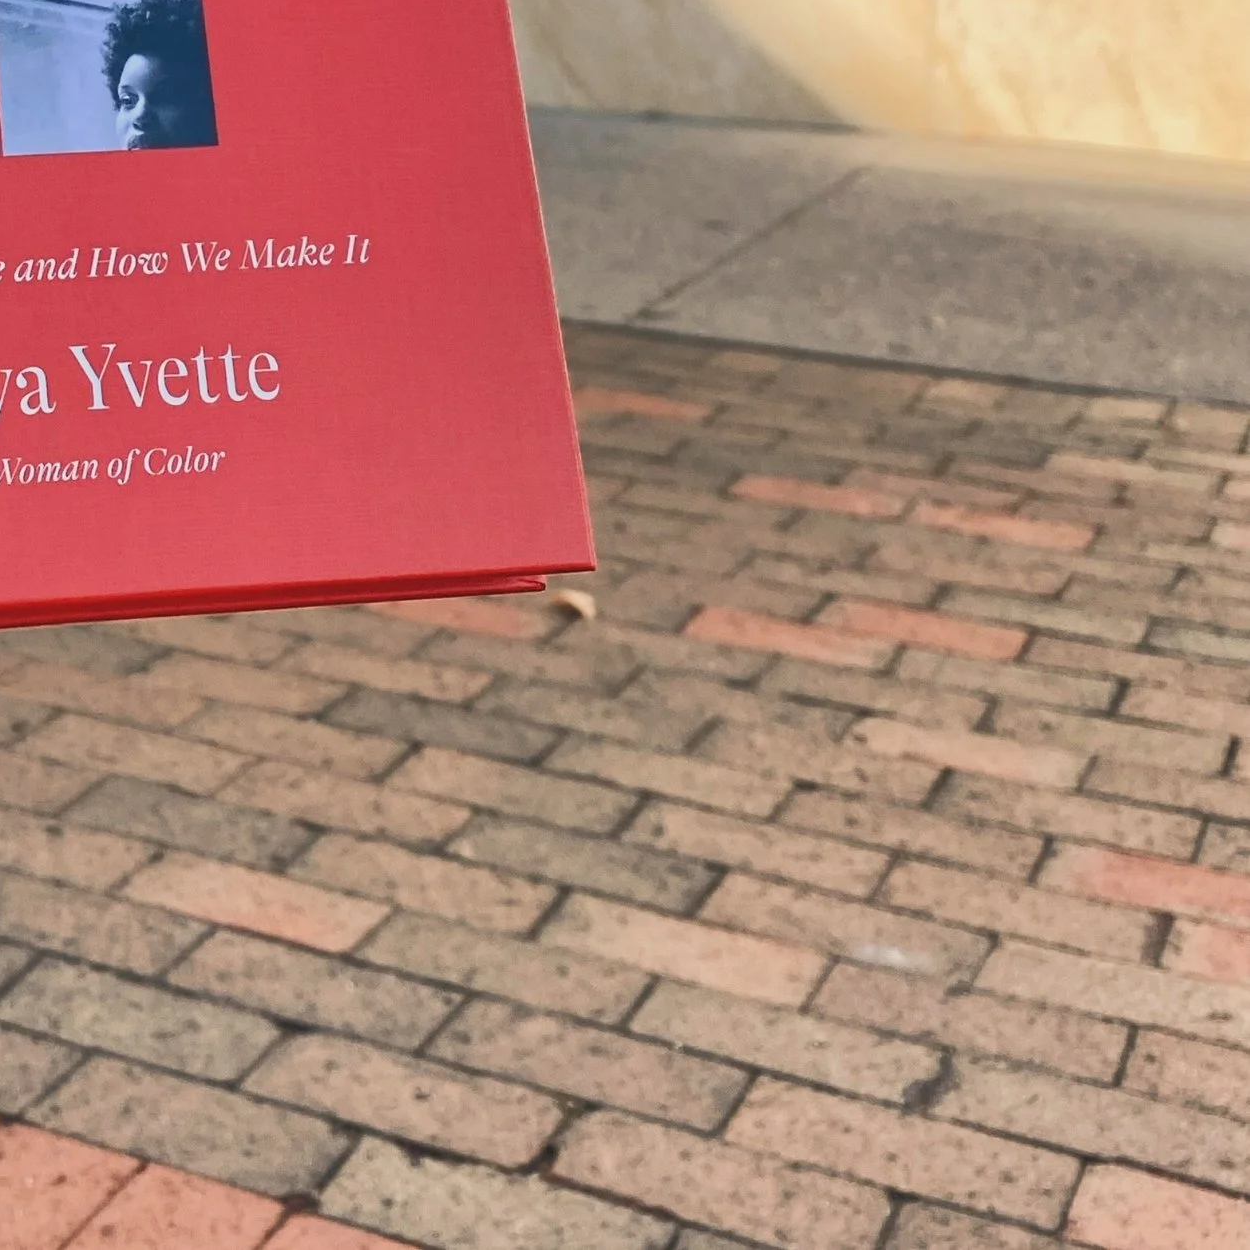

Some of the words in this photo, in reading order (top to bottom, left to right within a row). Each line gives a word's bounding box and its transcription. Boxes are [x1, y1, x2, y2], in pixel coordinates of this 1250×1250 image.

[13, 247, 80, 282] and
[89, 246, 169, 278] How
[180, 241, 231, 273] We
[240, 236, 335, 270] Make
[344, 234, 370, 264] It
[68, 343, 280, 410] Yvette
[107, 448, 141, 486] of
[143, 445, 226, 477] Color
